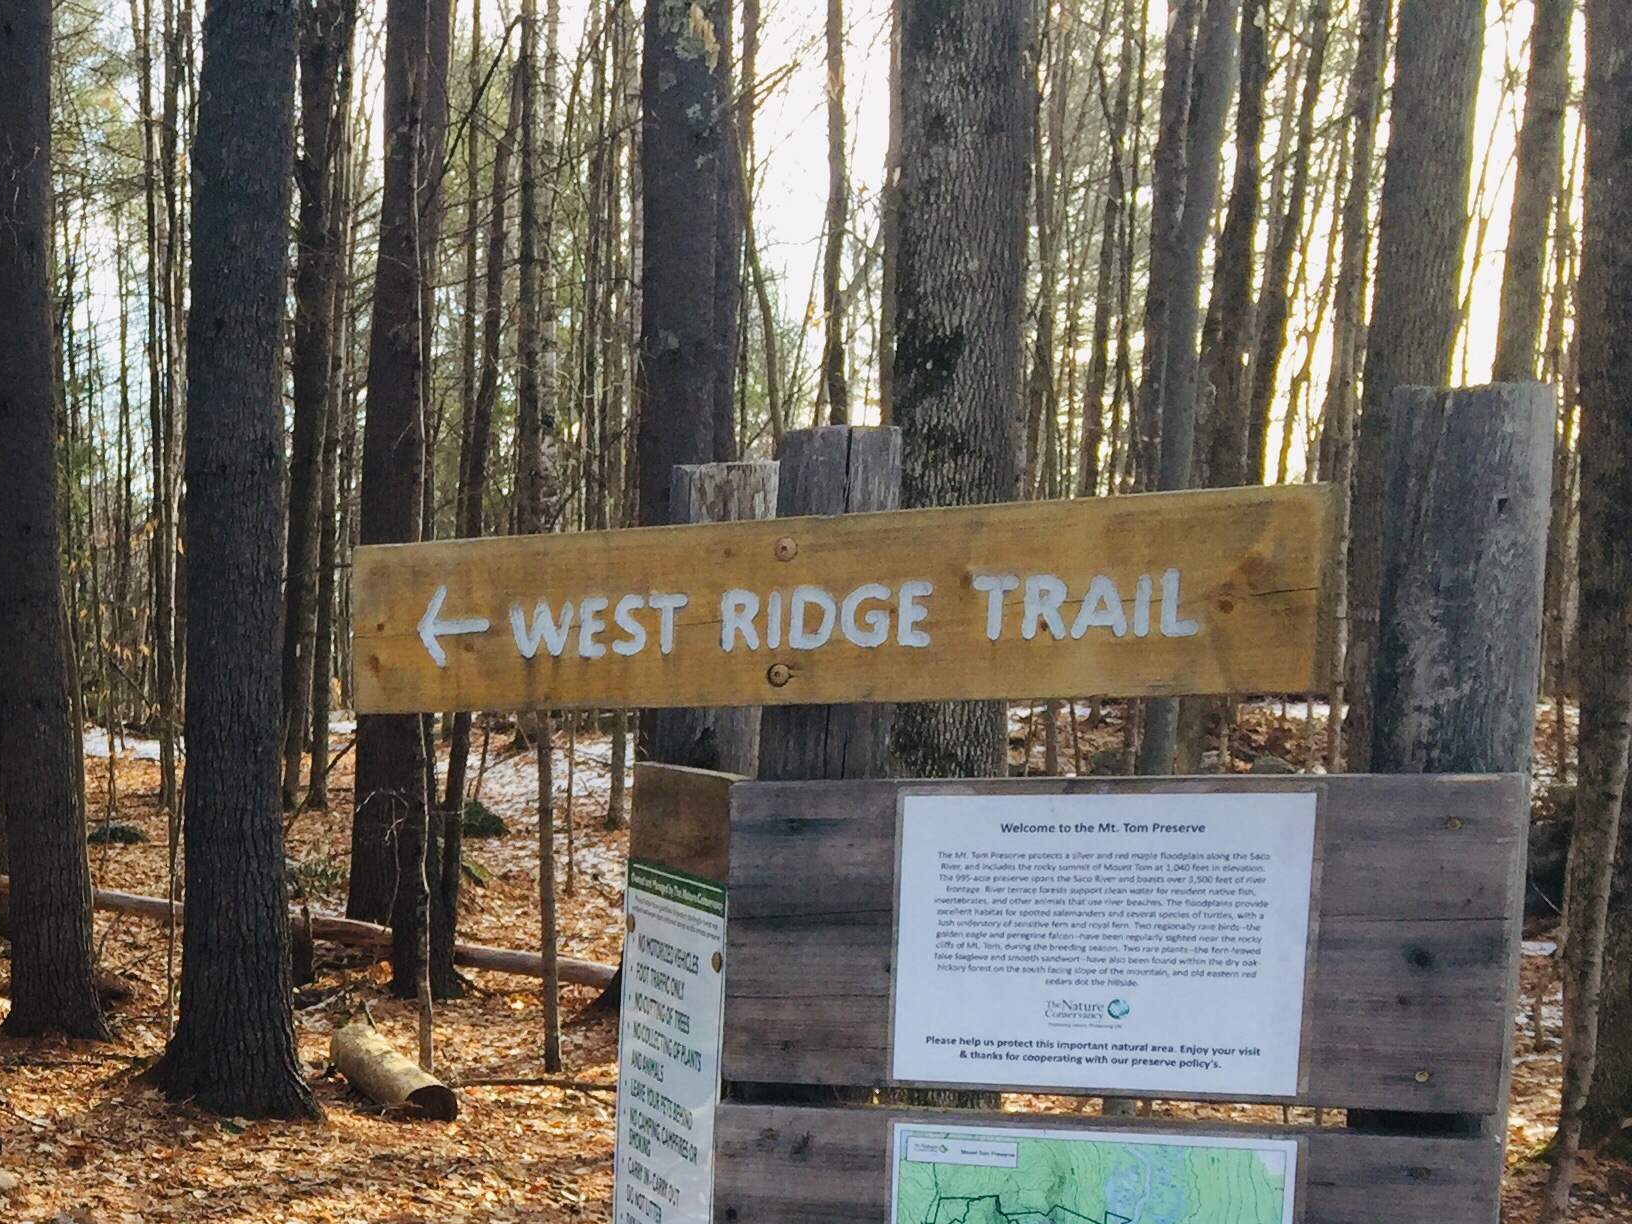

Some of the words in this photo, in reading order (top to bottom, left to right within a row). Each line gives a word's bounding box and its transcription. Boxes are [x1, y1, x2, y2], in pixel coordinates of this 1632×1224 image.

[511, 593, 688, 660] WEST
[720, 580, 932, 652] RIDGE
[972, 567, 1200, 640] TRAIL
[1000, 823, 1055, 834] Welcome
[1059, 823, 1071, 834] to
[1074, 823, 1094, 834] the
[1098, 823, 1120, 834] Mt.
[1123, 823, 1148, 834] Tom
[1152, 823, 1206, 834] Preserve
[1047, 1000, 1061, 1008] The
[1063, 1000, 1104, 1012] Nature
[1045, 1010, 1102, 1022] Conservancy
[926, 1036, 957, 1046] Please
[959, 1037, 981, 1049] help
[997, 1038, 1033, 1051] protect
[1036, 1040, 1054, 1049] this
[1057, 1040, 1108, 1053] important
[1111, 1042, 1148, 1052] natural
[1180, 1044, 1209, 1056] Enjoy
[1212, 1048, 1236, 1057] your
[1238, 1046, 1261, 1056] visit
[959, 1050, 967, 1059] &
[970, 1050, 1003, 1060] thanks
[1006, 1052, 1020, 1061] for
[1022, 1052, 1083, 1065] cooperating
[1085, 1054, 1108, 1064] with
[1131, 1058, 1177, 1069] preserve
[1179, 1058, 1222, 1070] policy's.
